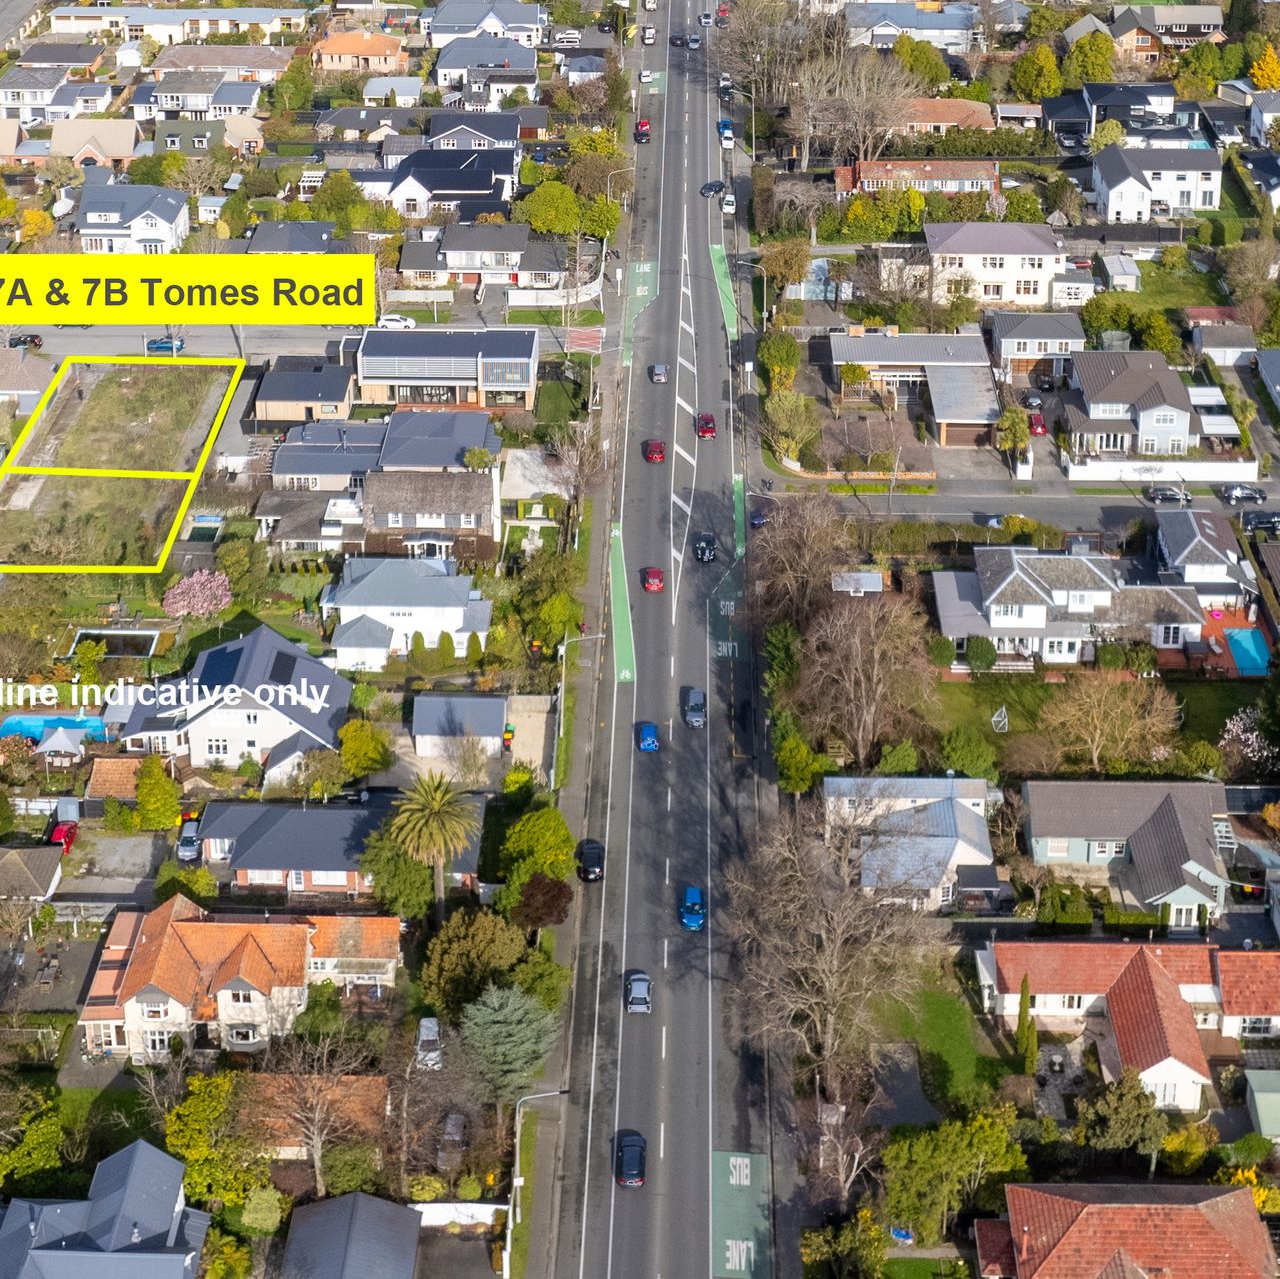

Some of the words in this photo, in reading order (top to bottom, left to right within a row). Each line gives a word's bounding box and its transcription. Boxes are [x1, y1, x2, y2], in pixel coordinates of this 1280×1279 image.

[720, 601, 735, 616] BUS
[717, 641, 739, 658] LANE
[729, 1156, 751, 1186] BUS
[725, 1239, 755, 1272] LANE
